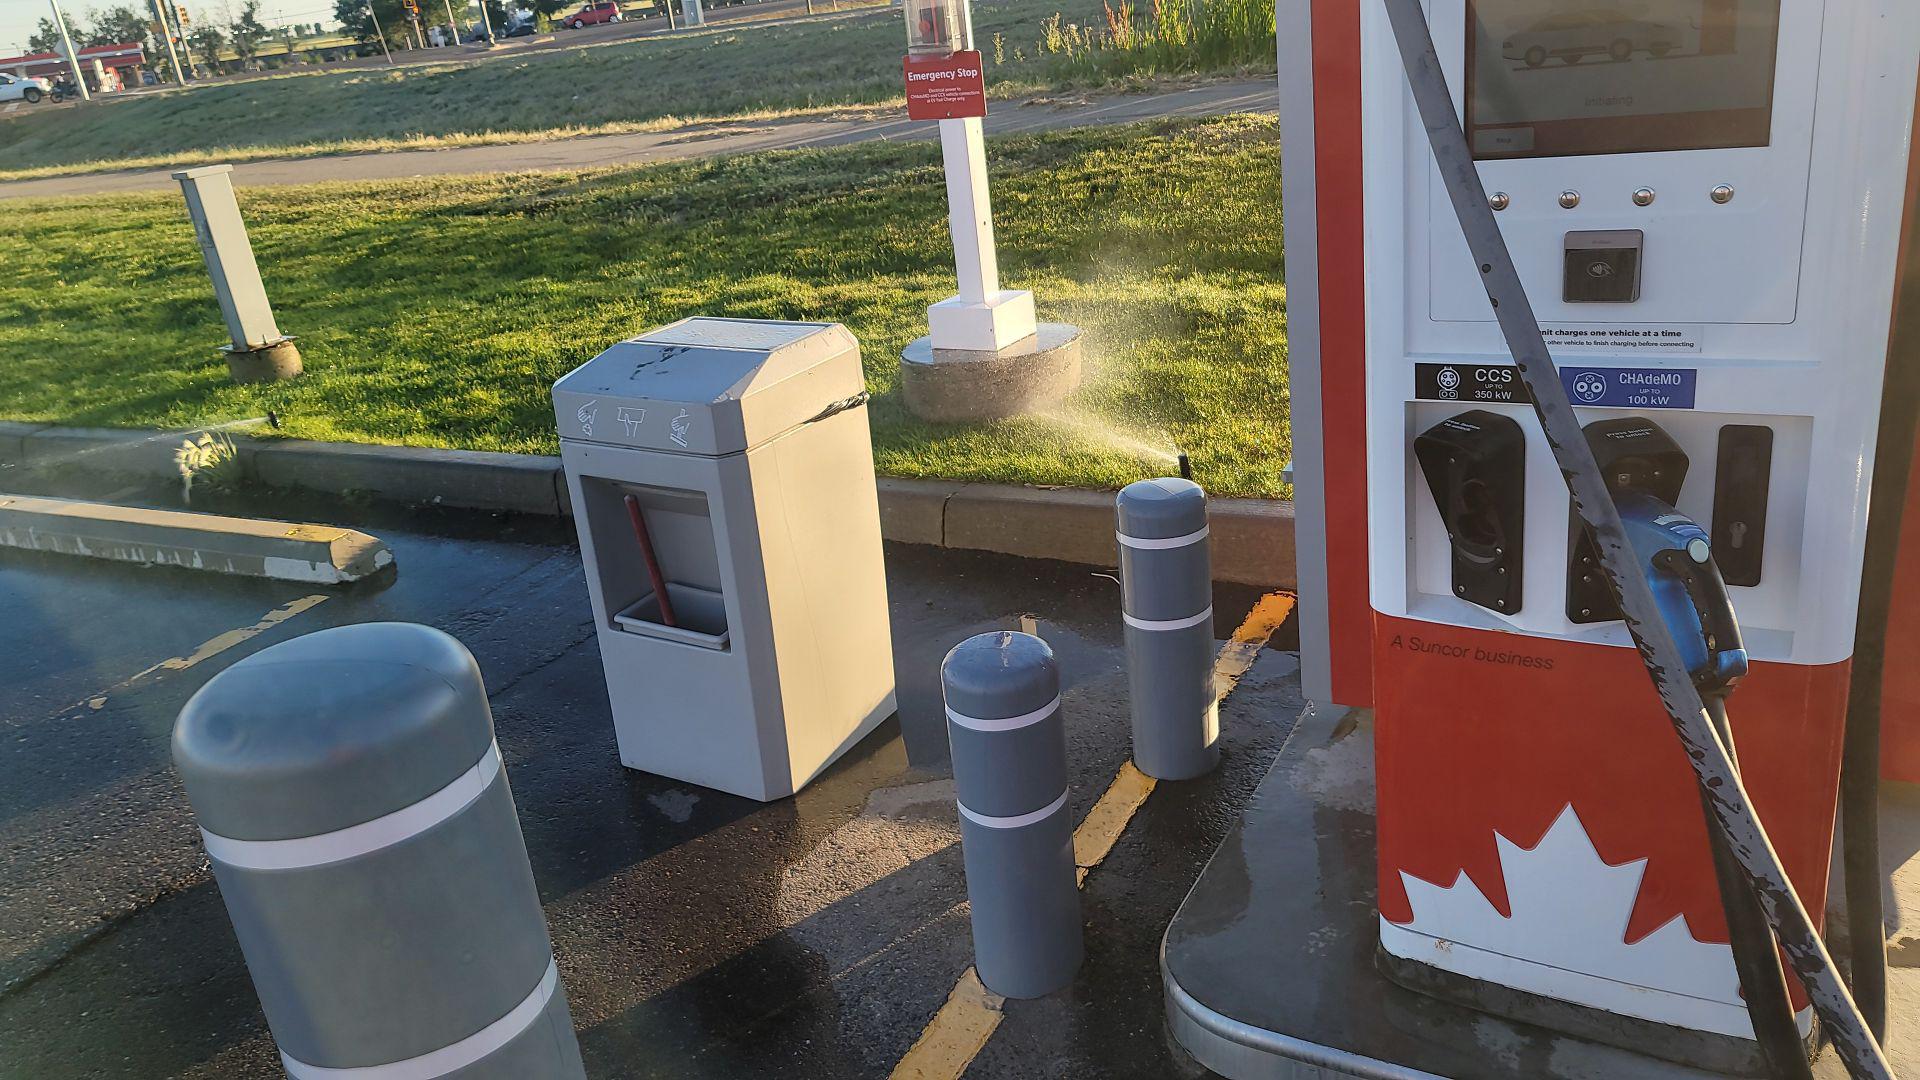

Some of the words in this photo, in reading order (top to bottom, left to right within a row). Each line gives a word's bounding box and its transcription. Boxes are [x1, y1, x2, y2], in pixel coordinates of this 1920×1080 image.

[907, 70, 956, 82] Emergency
[957, 68, 978, 79] Stop
[1554, 328, 1588, 338] charges
[1608, 329, 1640, 337] vehicle
[1660, 329, 1682, 337] time
[1474, 368, 1512, 383] CCS
[1619, 372, 1681, 386] CHAdeMO
[1474, 390, 1493, 399] 350
[1495, 390, 1512, 400] kW
[1627, 395, 1648, 405] 100
[1650, 396, 1670, 405] kW
[1390, 635, 1404, 649] A
[1408, 636, 1471, 659] Suncor
[1474, 645, 1555, 671] business
